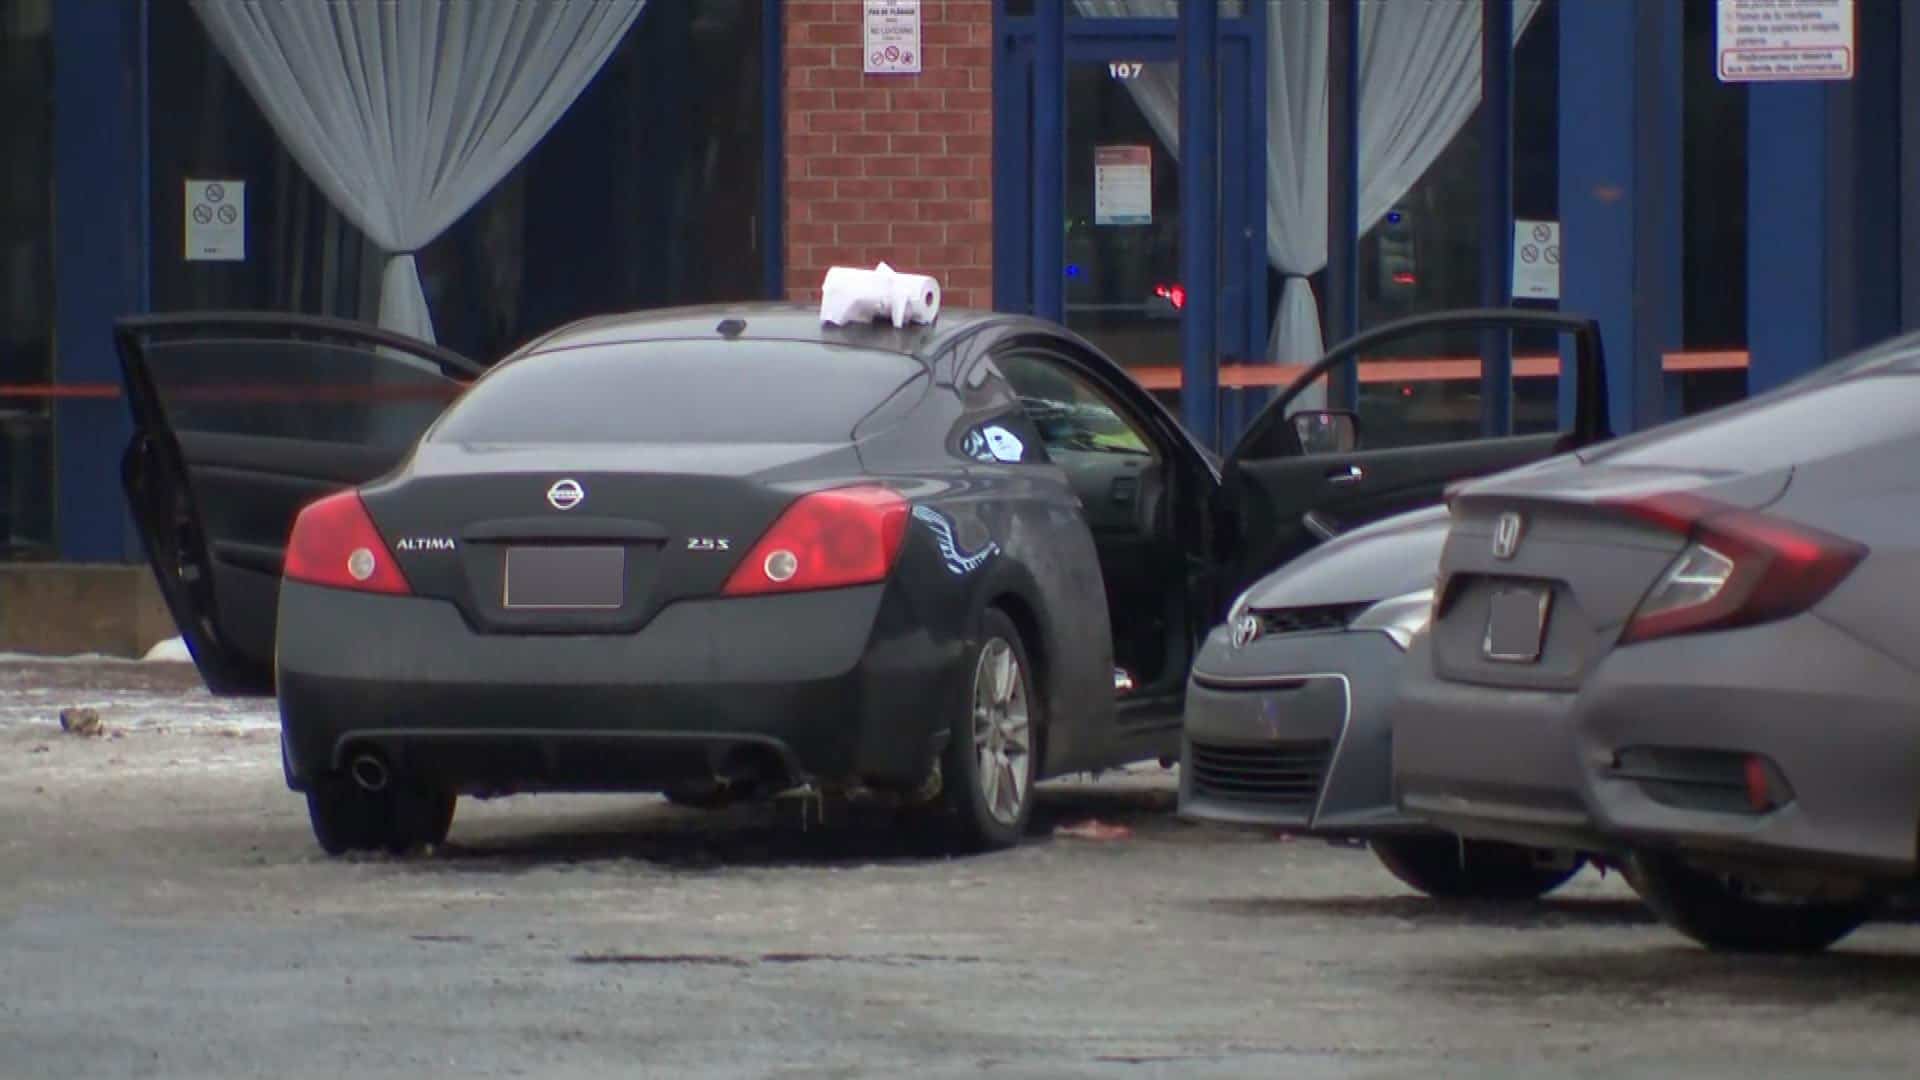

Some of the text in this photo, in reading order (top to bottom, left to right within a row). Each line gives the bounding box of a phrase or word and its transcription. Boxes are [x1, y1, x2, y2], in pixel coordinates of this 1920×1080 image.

[1108, 63, 1143, 78] 107
[396, 537, 455, 550] ALTIMA
[717, 537, 729, 550] S
